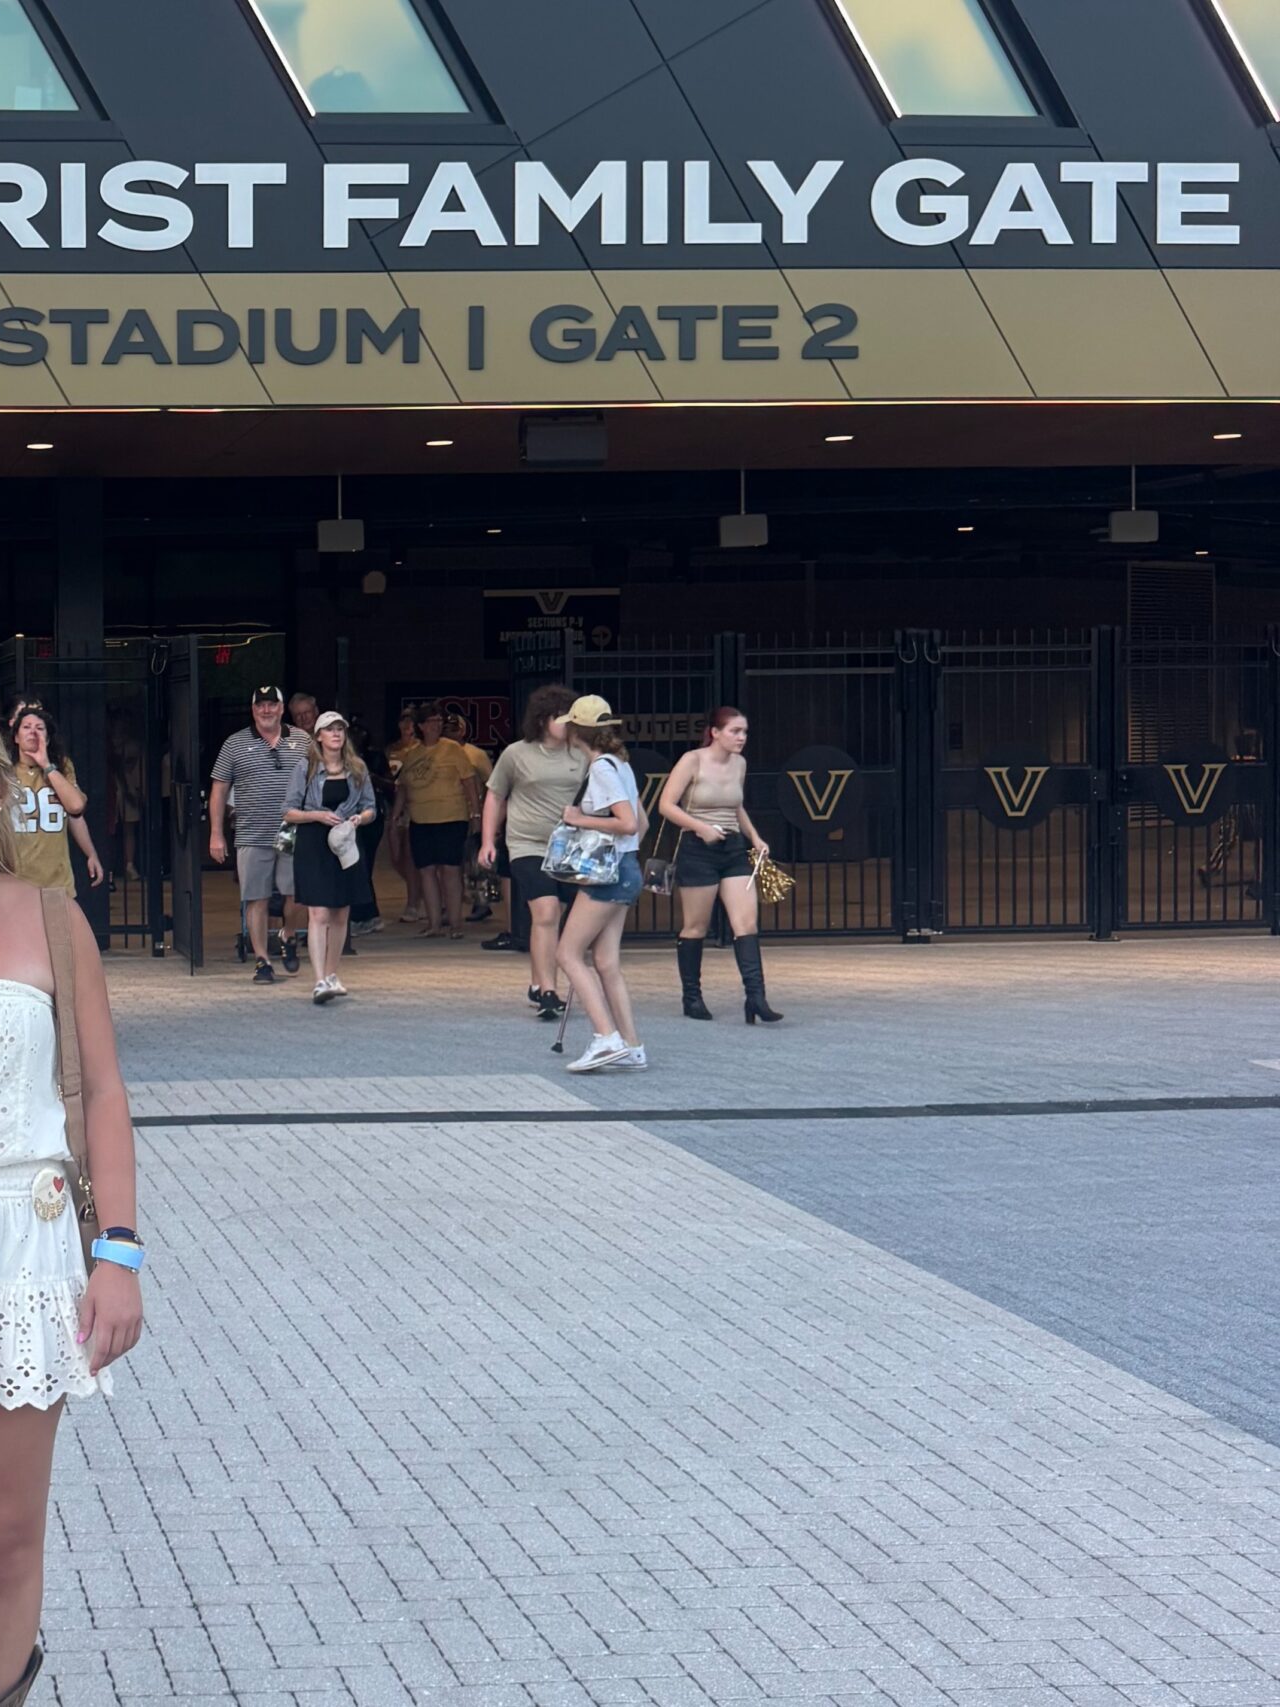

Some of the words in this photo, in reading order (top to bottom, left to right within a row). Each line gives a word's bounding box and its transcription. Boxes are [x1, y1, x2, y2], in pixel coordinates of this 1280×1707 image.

[323, 160, 844, 249] FAMILY
[870, 158, 1241, 246] GATE
[529, 304, 780, 365] GATE
[800, 302, 860, 363] 2
[614, 719, 706, 735] UITES
[10, 785, 65, 833] 26
[786, 769, 854, 821] V
[983, 766, 1050, 818] V
[1162, 763, 1228, 814] V
